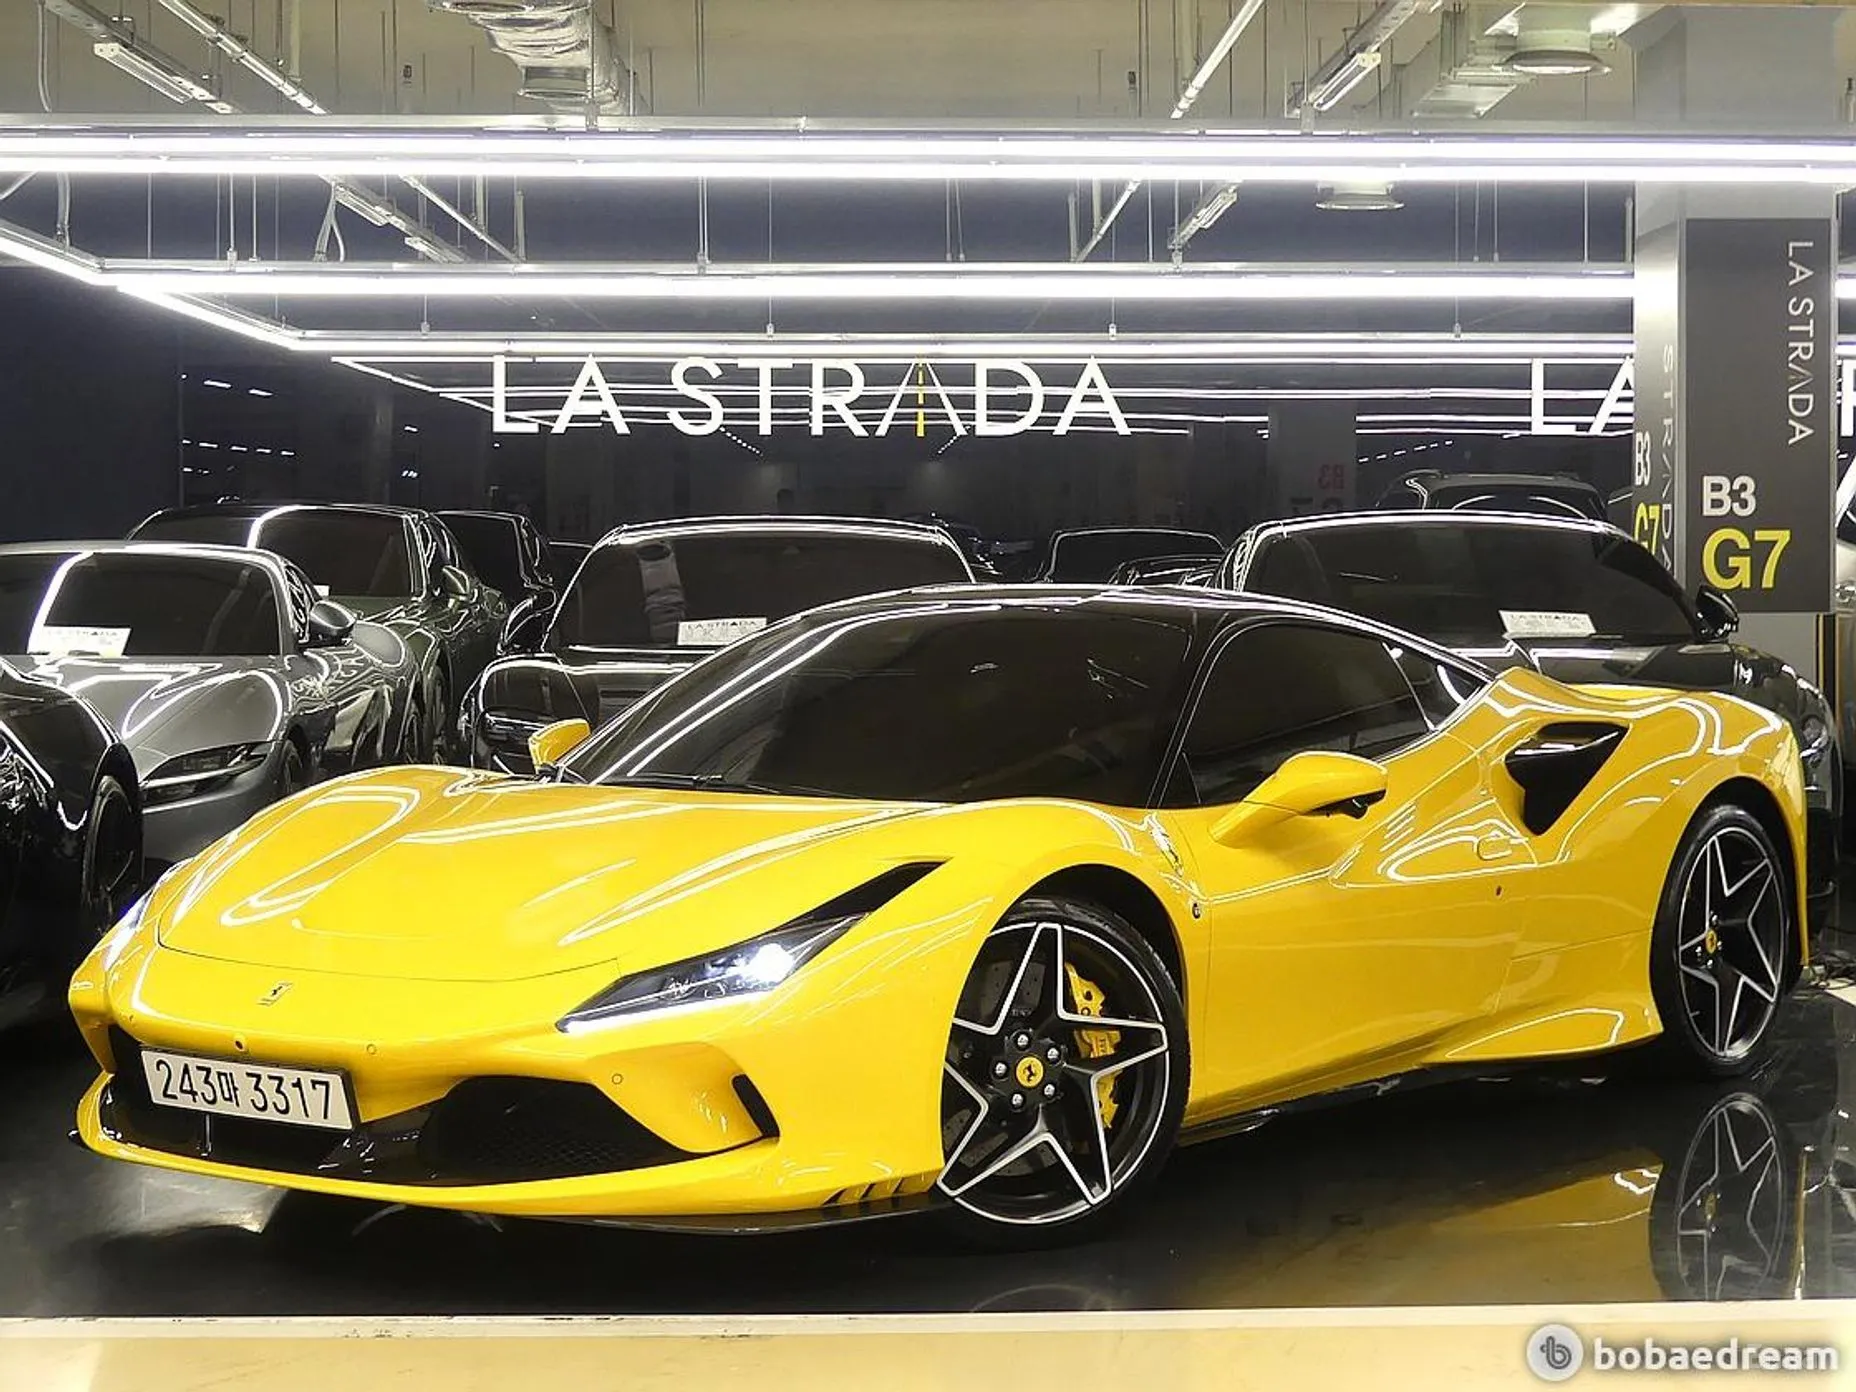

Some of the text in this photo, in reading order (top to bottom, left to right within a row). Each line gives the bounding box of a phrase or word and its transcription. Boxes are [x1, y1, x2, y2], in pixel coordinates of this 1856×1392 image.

[1788, 240, 1815, 446] LA STRADA
[491, 354, 1132, 437] LA STRADA
[1636, 431, 1651, 487] B3
[1702, 475, 1757, 517] B3
[1701, 528, 1791, 590] G7
[155, 1059, 331, 1120] 243마 3317
